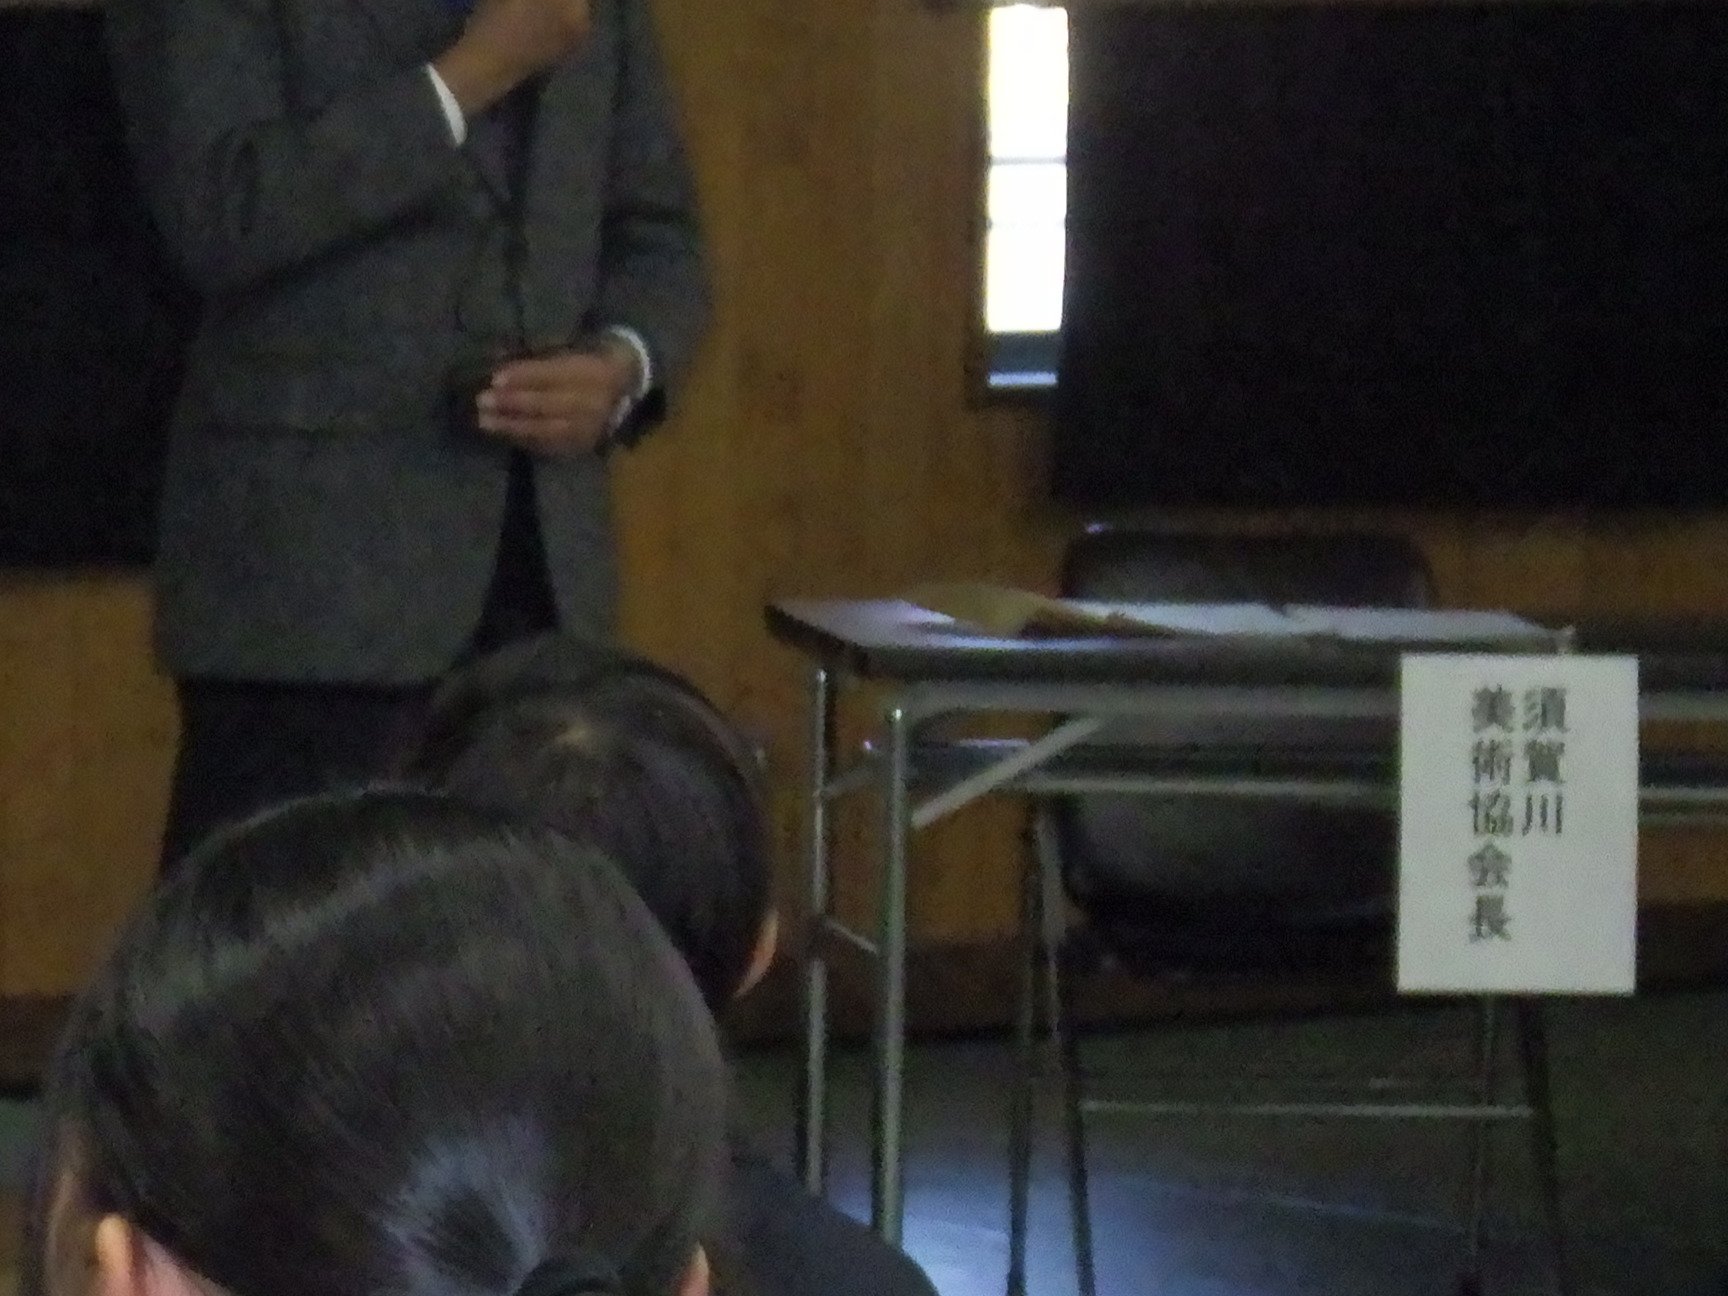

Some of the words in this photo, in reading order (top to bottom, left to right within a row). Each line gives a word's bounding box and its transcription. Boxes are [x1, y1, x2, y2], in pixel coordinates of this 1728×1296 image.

[1467, 683, 1516, 944] 美術協会長
[1522, 685, 1569, 836] 須賀川
